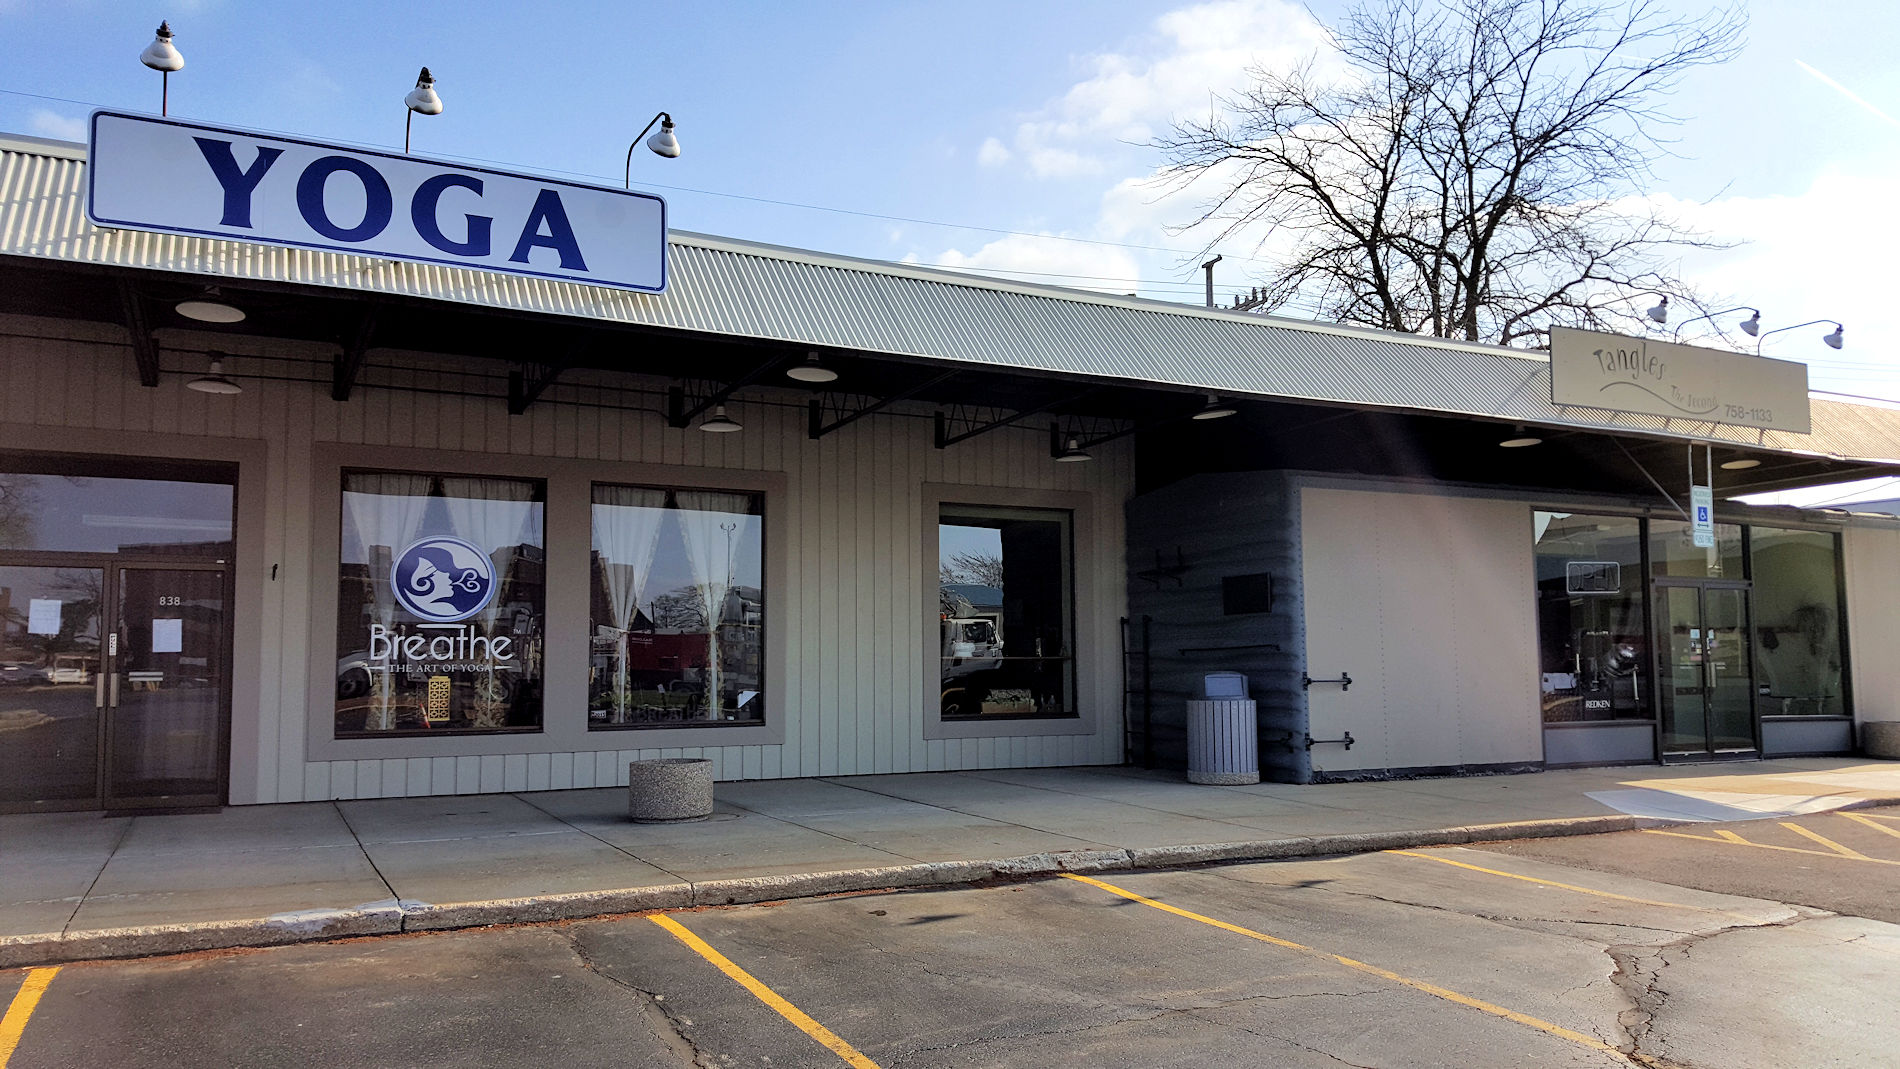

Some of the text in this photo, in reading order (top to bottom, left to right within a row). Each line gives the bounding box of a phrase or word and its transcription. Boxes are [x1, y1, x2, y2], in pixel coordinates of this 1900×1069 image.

[192, 136, 590, 272] YOGA
[1592, 342, 1665, 380] Tangles
[1671, 384, 1719, 408] The Second
[1724, 403, 1774, 423] 758-1133
[1569, 564, 1619, 590] OPEN
[159, 597, 180, 605] 838
[371, 624, 513, 660] Breathe
[389, 664, 492, 673] THE ART OF YOGA
[1585, 699, 1611, 709] REDKEN
